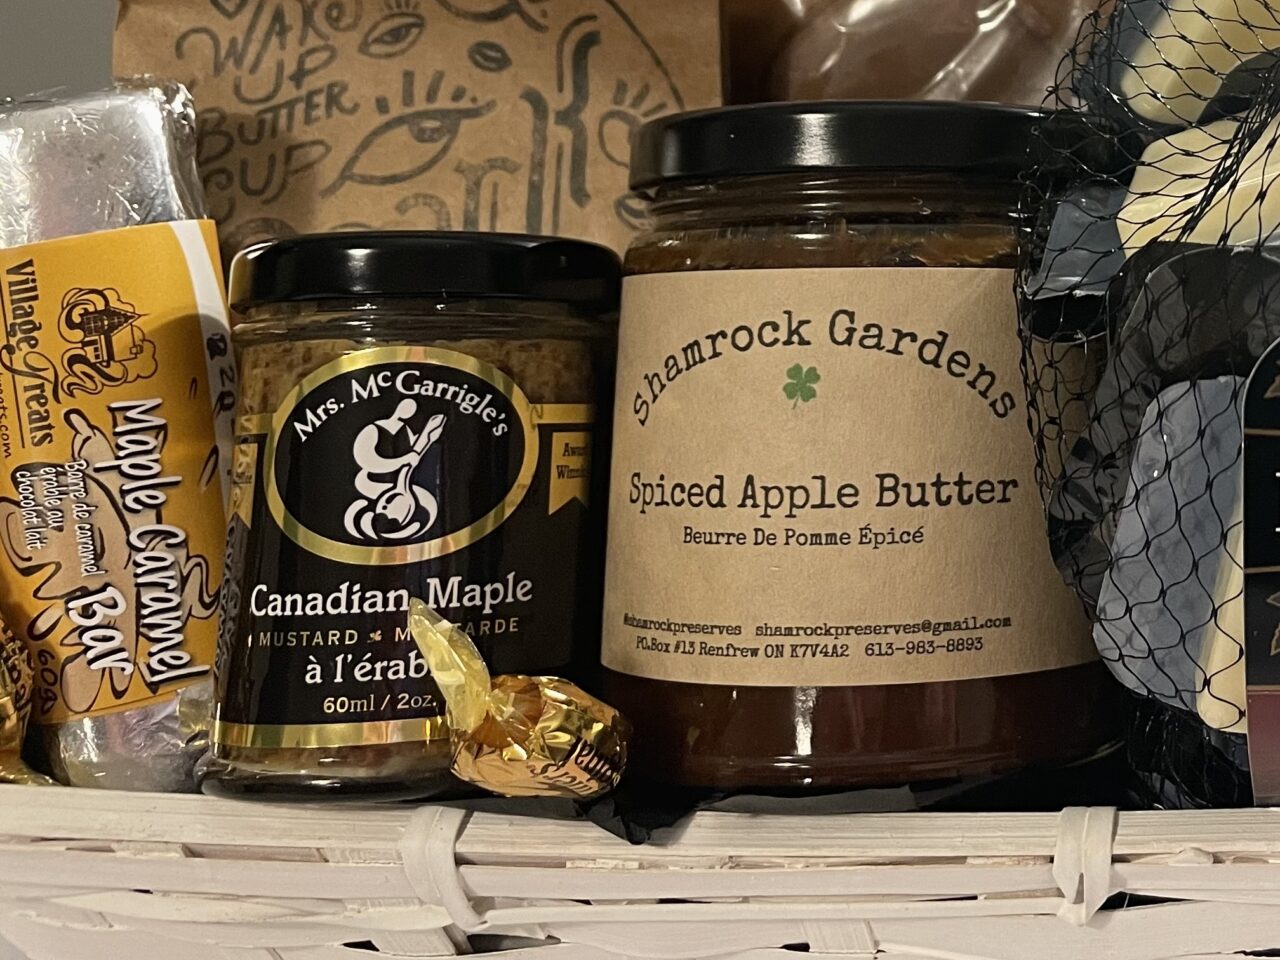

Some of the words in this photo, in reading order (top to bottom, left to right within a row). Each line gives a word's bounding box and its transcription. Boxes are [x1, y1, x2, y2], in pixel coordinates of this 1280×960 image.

[233, 43, 338, 106] UP
[200, 80, 361, 170] BUTTER
[202, 139, 333, 228] CUP
[6, 257, 42, 352] Village
[632, 309, 812, 427] Shamrock
[828, 308, 1017, 420] Gardens
[0, 343, 62, 449] Treats
[291, 395, 346, 443] Mrs.
[350, 368, 509, 438] McGarrigle's
[94, 396, 182, 515] Maple
[16, 470, 41, 525] chocolat
[40, 466, 62, 507] érable
[65, 459, 88, 501] Barre
[629, 471, 727, 514] Spiced
[737, 473, 861, 519] Apple
[875, 472, 1019, 508] Butter
[47, 510, 64, 530] au
[72, 503, 97, 520] de
[25, 526, 49, 551] lait
[75, 523, 108, 577] caramel
[683, 526, 747, 546] Beurre
[753, 527, 777, 546] De
[784, 528, 851, 547] Pomme
[858, 523, 924, 550] Épicé
[127, 524, 211, 685] Caramel
[249, 580, 411, 617] Canadian
[426, 570, 534, 616] Maple
[67, 586, 133, 678] Bar
[259, 628, 359, 647] MUSTARD
[394, 616, 520, 643] MARDE
[673, 640, 696, 656] #13
[698, 642, 761, 659] Renfrew
[764, 643, 784, 659] ON
[790, 643, 850, 659] K7V4A2
[865, 636, 984, 657] 613-983-8893
[755, 615, 1013, 641] shamrockpreserves@gmail.com
[304, 654, 323, 684] à
[322, 693, 376, 714] 60ml
[396, 692, 438, 710] 2oz.
